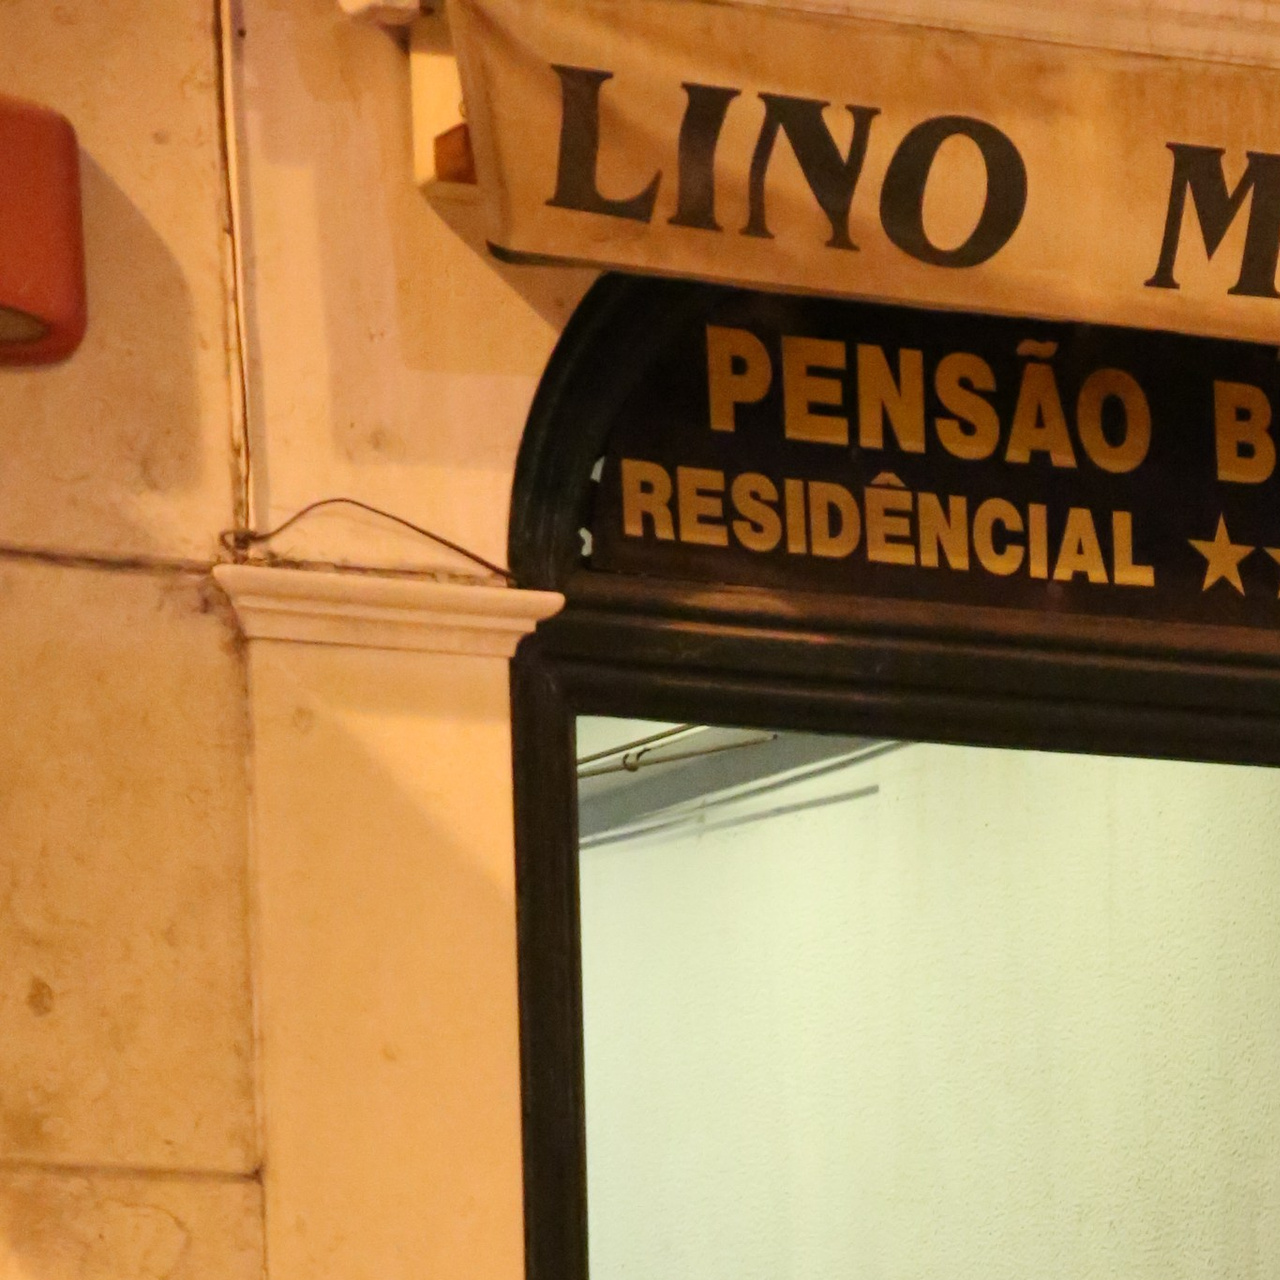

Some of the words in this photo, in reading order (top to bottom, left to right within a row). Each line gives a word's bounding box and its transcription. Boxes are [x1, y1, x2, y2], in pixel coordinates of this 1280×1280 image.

[545, 63, 1027, 268] LINO
[706, 324, 1152, 474] PENSÃO
[621, 457, 1154, 588] RESIDÊNCIAL
